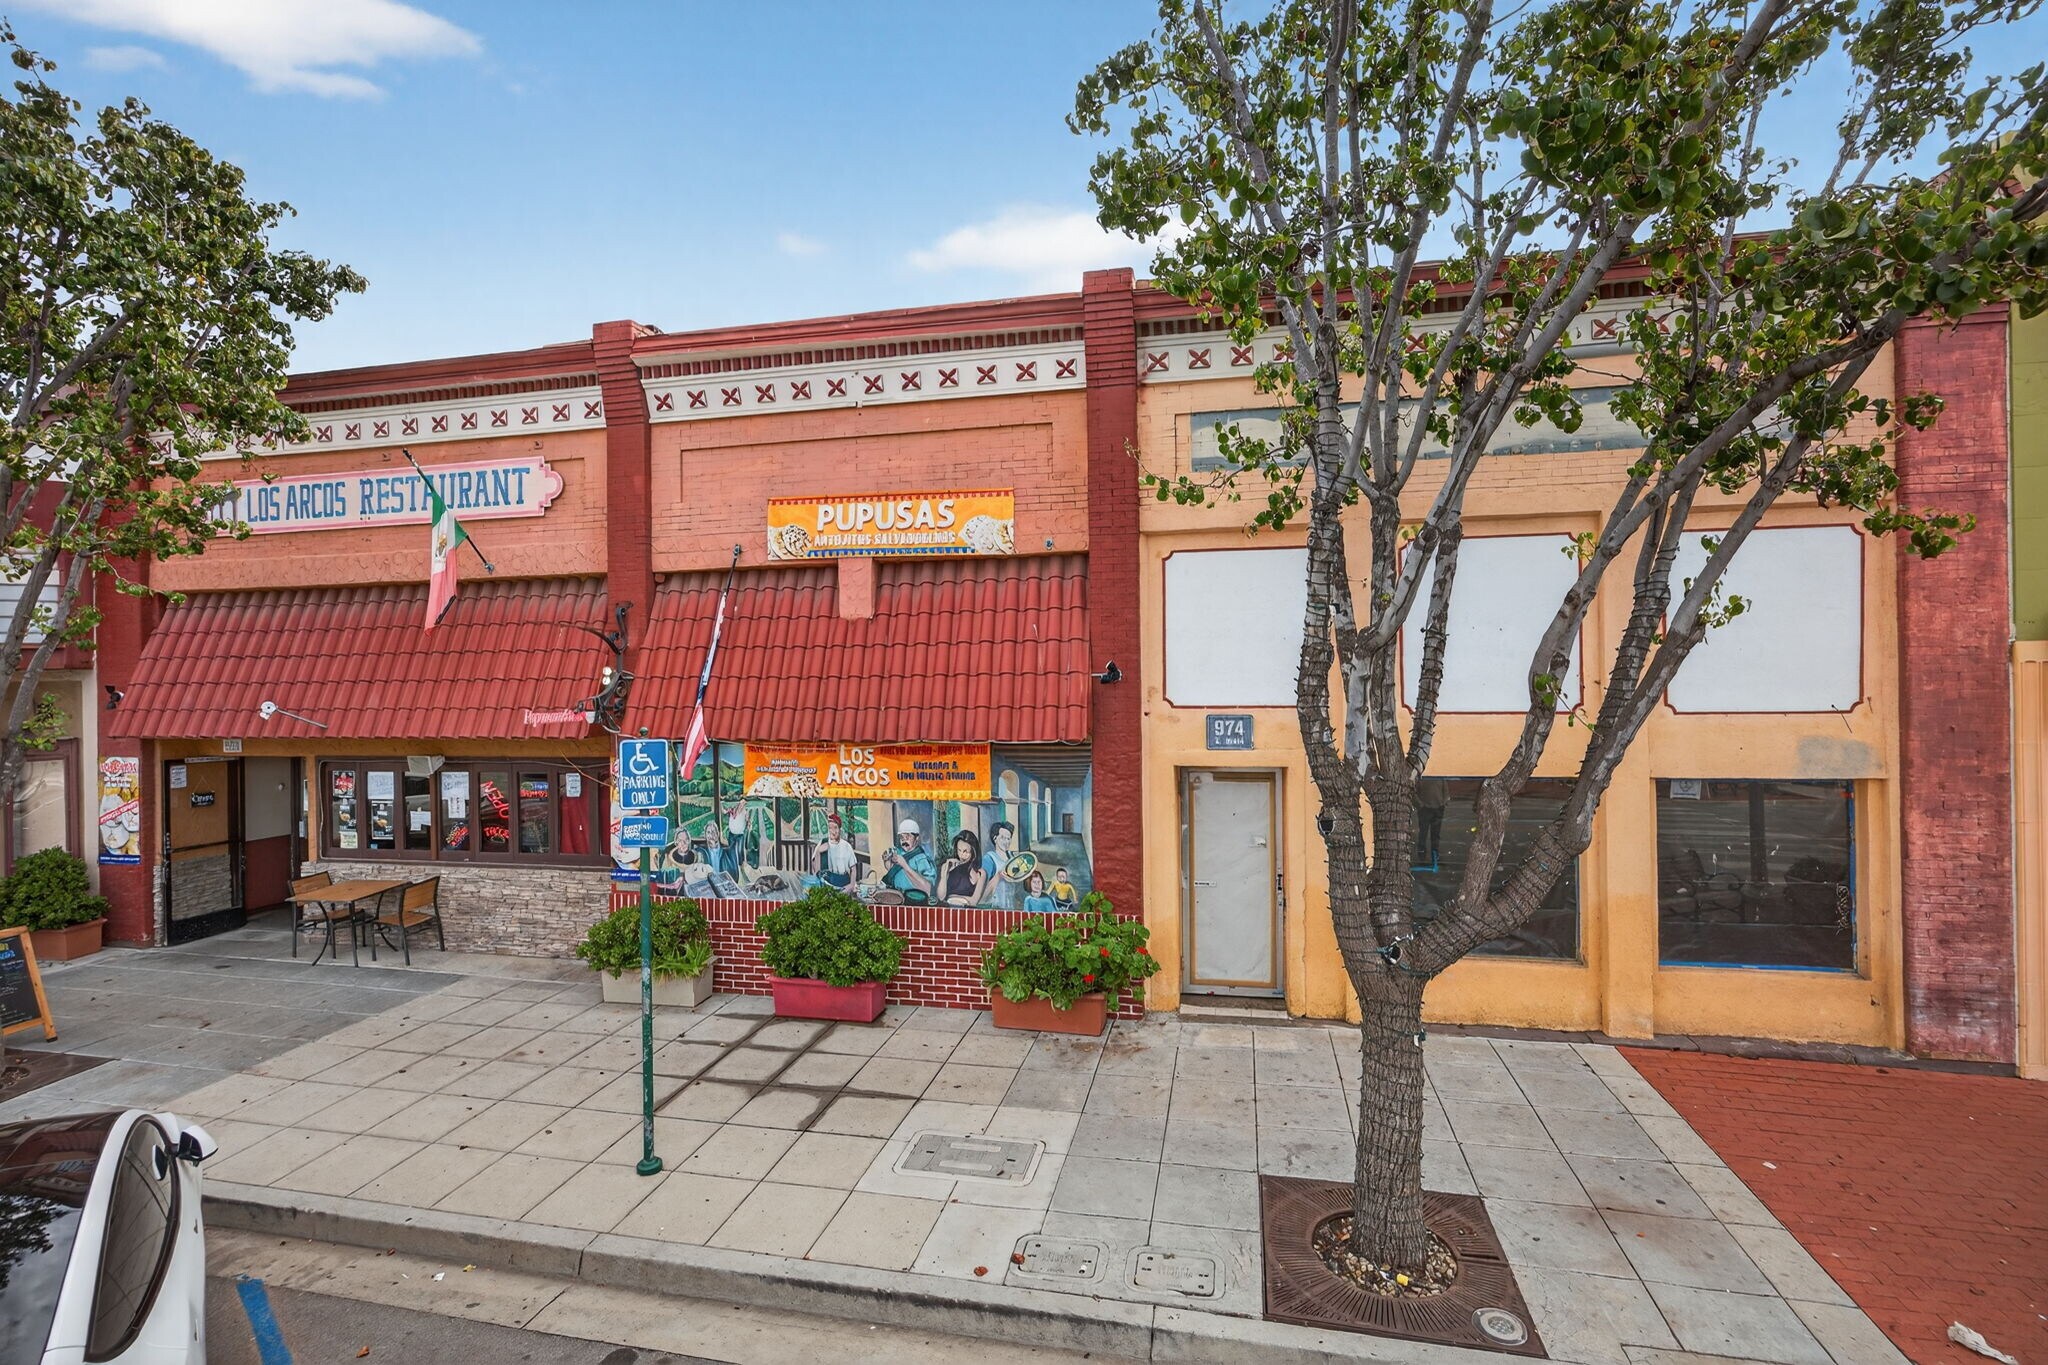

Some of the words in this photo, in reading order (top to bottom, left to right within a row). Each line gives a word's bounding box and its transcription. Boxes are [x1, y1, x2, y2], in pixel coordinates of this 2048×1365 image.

[247, 485, 281, 523] LOS
[285, 481, 346, 521] ARCOS
[359, 467, 531, 516] RESTAURANT
[816, 500, 956, 532] PUPUSAS
[1214, 719, 1245, 736] 974
[839, 744, 874, 765] LOS
[622, 774, 666, 790] PARKING
[826, 763, 891, 787] ARCOS
[631, 790, 657, 805] ONLY
